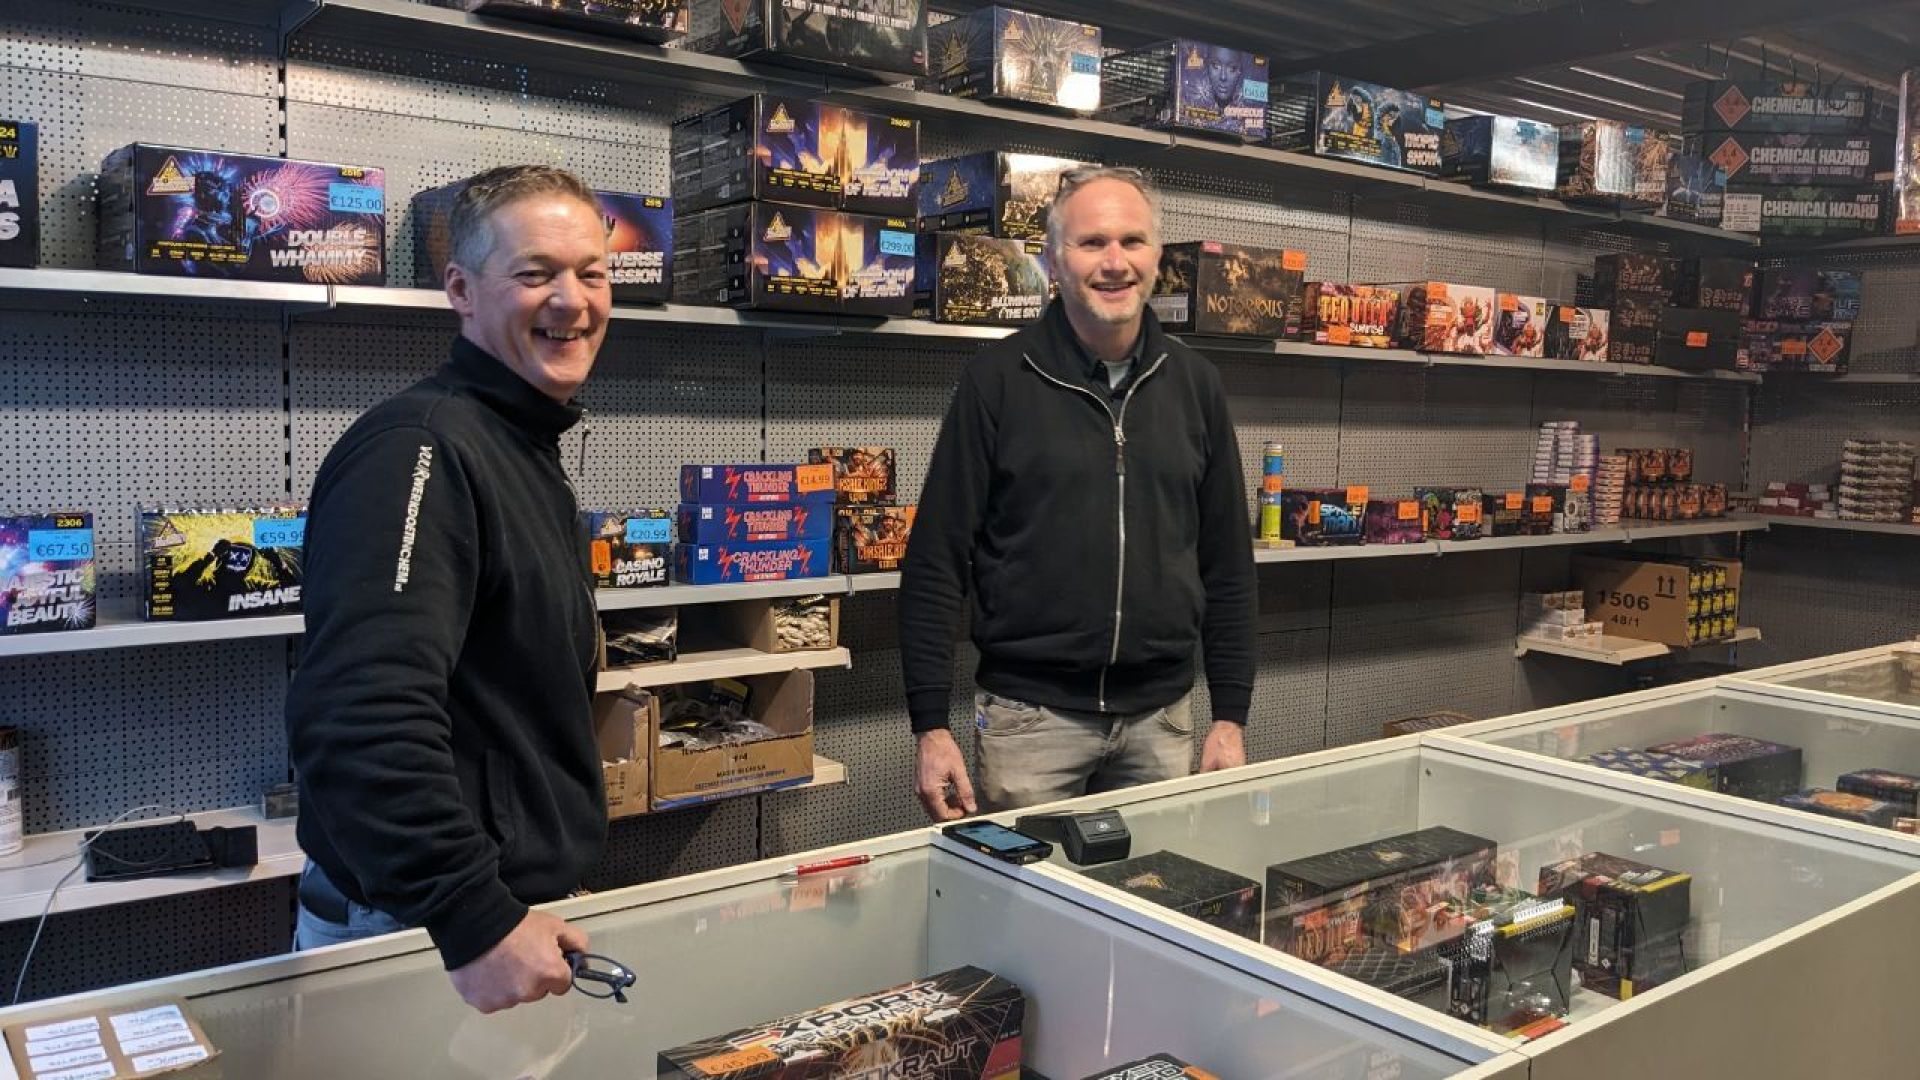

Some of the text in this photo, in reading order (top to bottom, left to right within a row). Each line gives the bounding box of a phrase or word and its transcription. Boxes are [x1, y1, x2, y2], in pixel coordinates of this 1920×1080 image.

[1752, 96, 1865, 117] CHEMICAL HAZARD
[1750, 147, 1870, 166] CHEMICAL HAZARD
[1763, 200, 1828, 218] CHEMICAL
[1829, 201, 1879, 219] HAZARD
[288, 230, 367, 247] DOUBLE
[270, 249, 367, 268] WHAMMY
[1206, 293, 1284, 319] NOTORIOUS
[743, 470, 793, 482] CRACKLING
[747, 482, 790, 493] THUNDER
[743, 510, 793, 523] CRACKLING
[747, 520, 788, 532] THUNDER
[36, 541, 90, 557] €67.50
[732, 549, 799, 563] CRACKLING
[615, 557, 664, 574] CASINO
[738, 560, 793, 574] THUNDER
[616, 568, 667, 587] ROYALE
[228, 584, 301, 612] INSANE
[1596, 589, 1650, 611] 1506
[1610, 614, 1640, 629] 48/1
